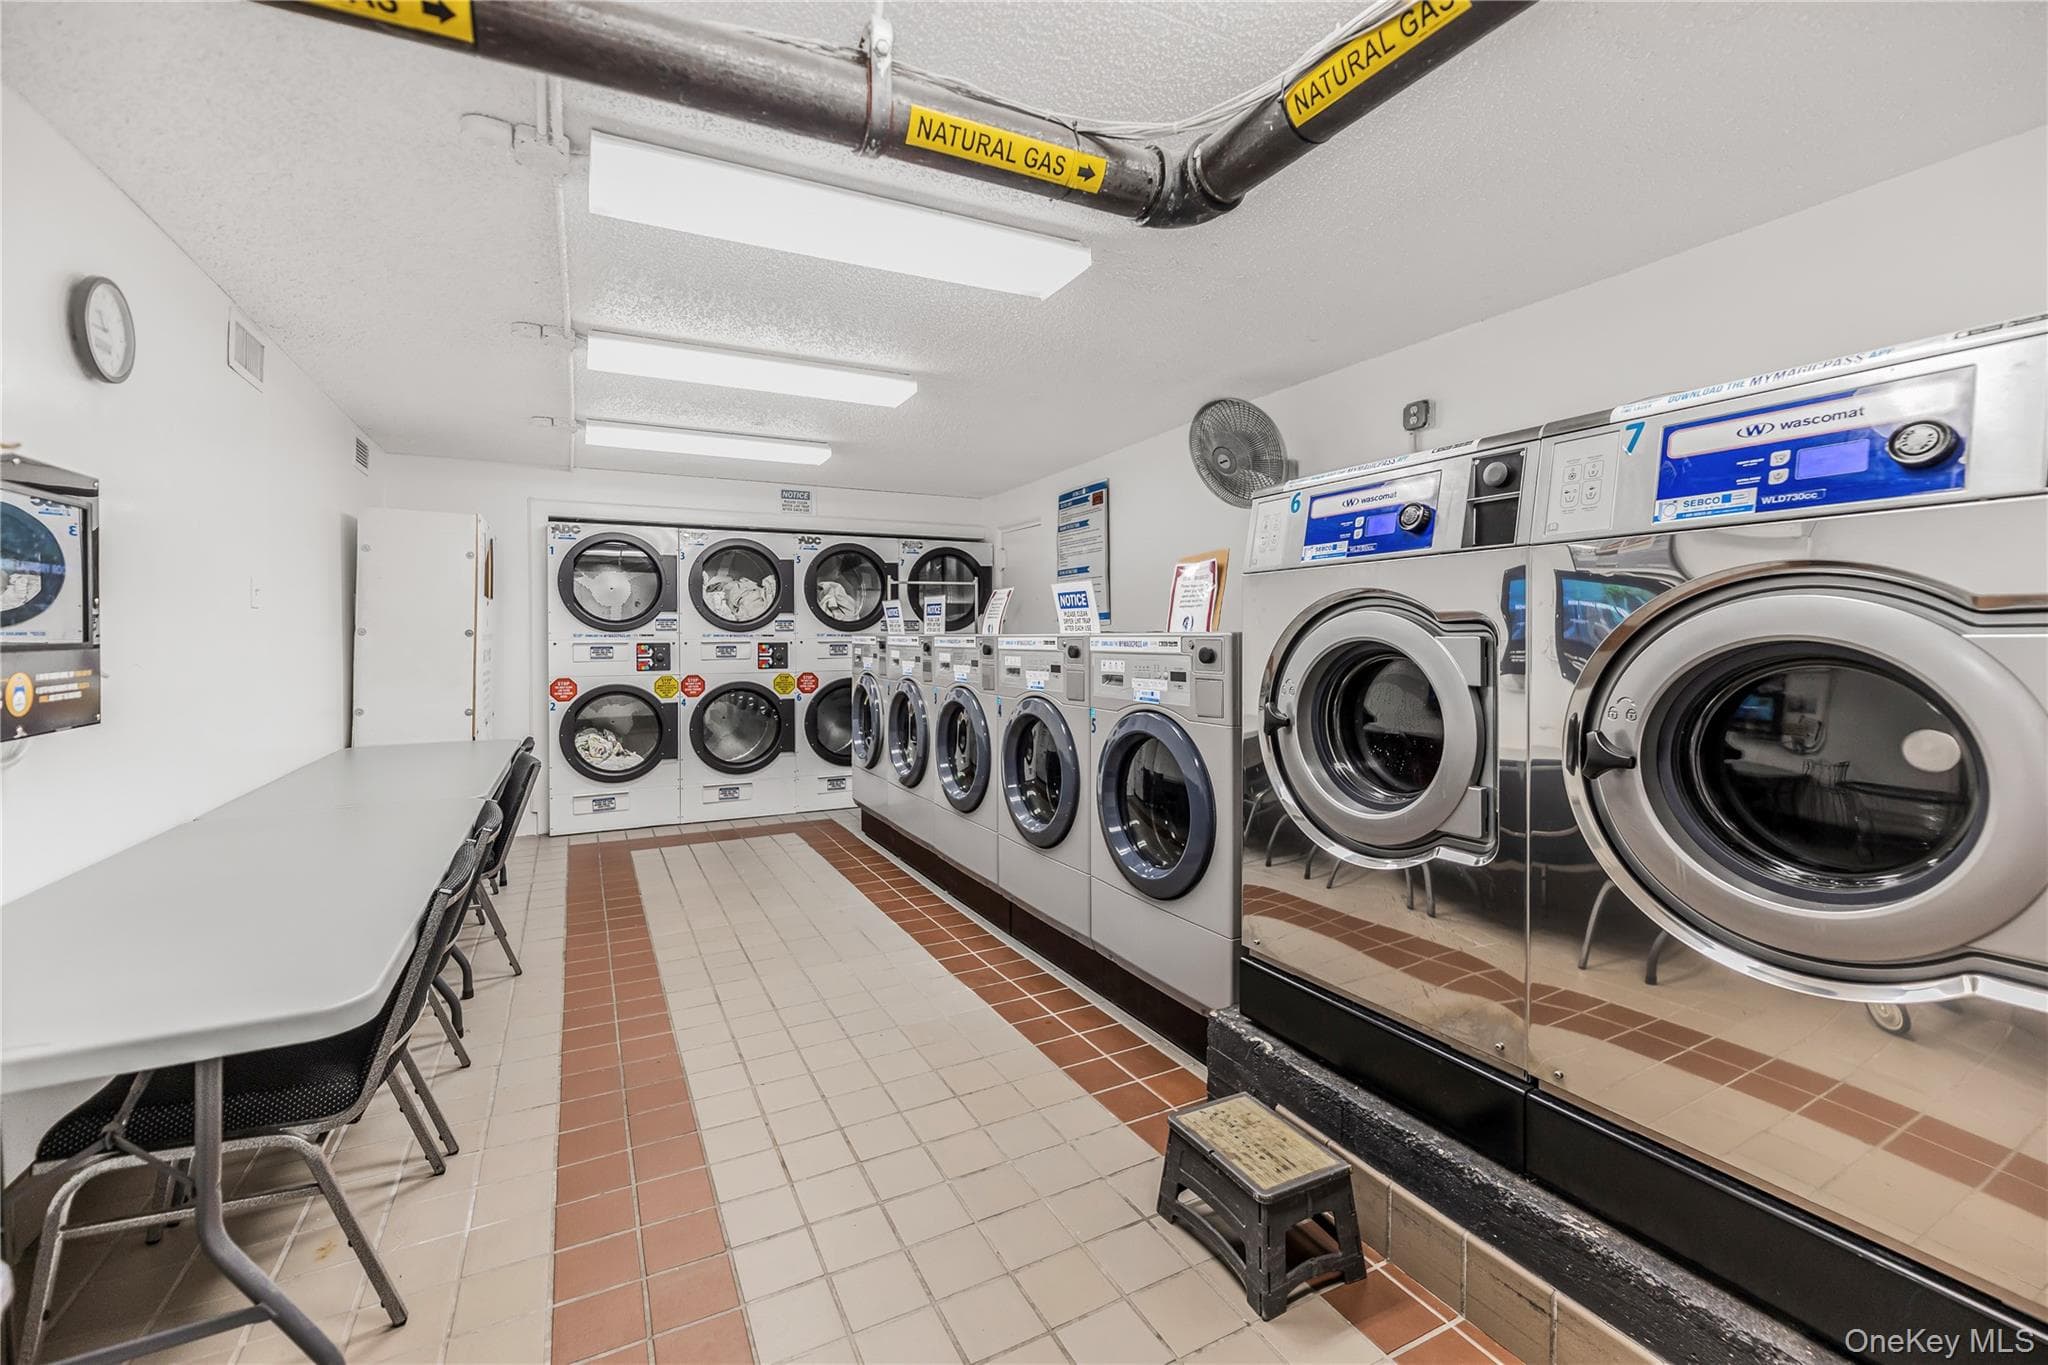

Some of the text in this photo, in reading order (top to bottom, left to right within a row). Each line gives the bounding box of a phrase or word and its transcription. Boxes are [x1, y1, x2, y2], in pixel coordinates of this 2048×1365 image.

[1293, 30, 1396, 115] NATURAL
[916, 116, 1067, 176] NATURAL GAS
[1667, 385, 1723, 404] DOWNLOAD
[1726, 381, 1745, 391] THE
[1780, 405, 1866, 431] wascomat
[1624, 421, 1646, 455] 7
[783, 490, 809, 500] NOTICE
[1291, 492, 1301, 513] 6
[1360, 491, 1398, 505] wascomat
[1682, 496, 1721, 508] SEBCO
[1060, 593, 1088, 607] NOTICE
[550, 702, 556, 711] 2
[1091, 717, 1097, 734] 5
